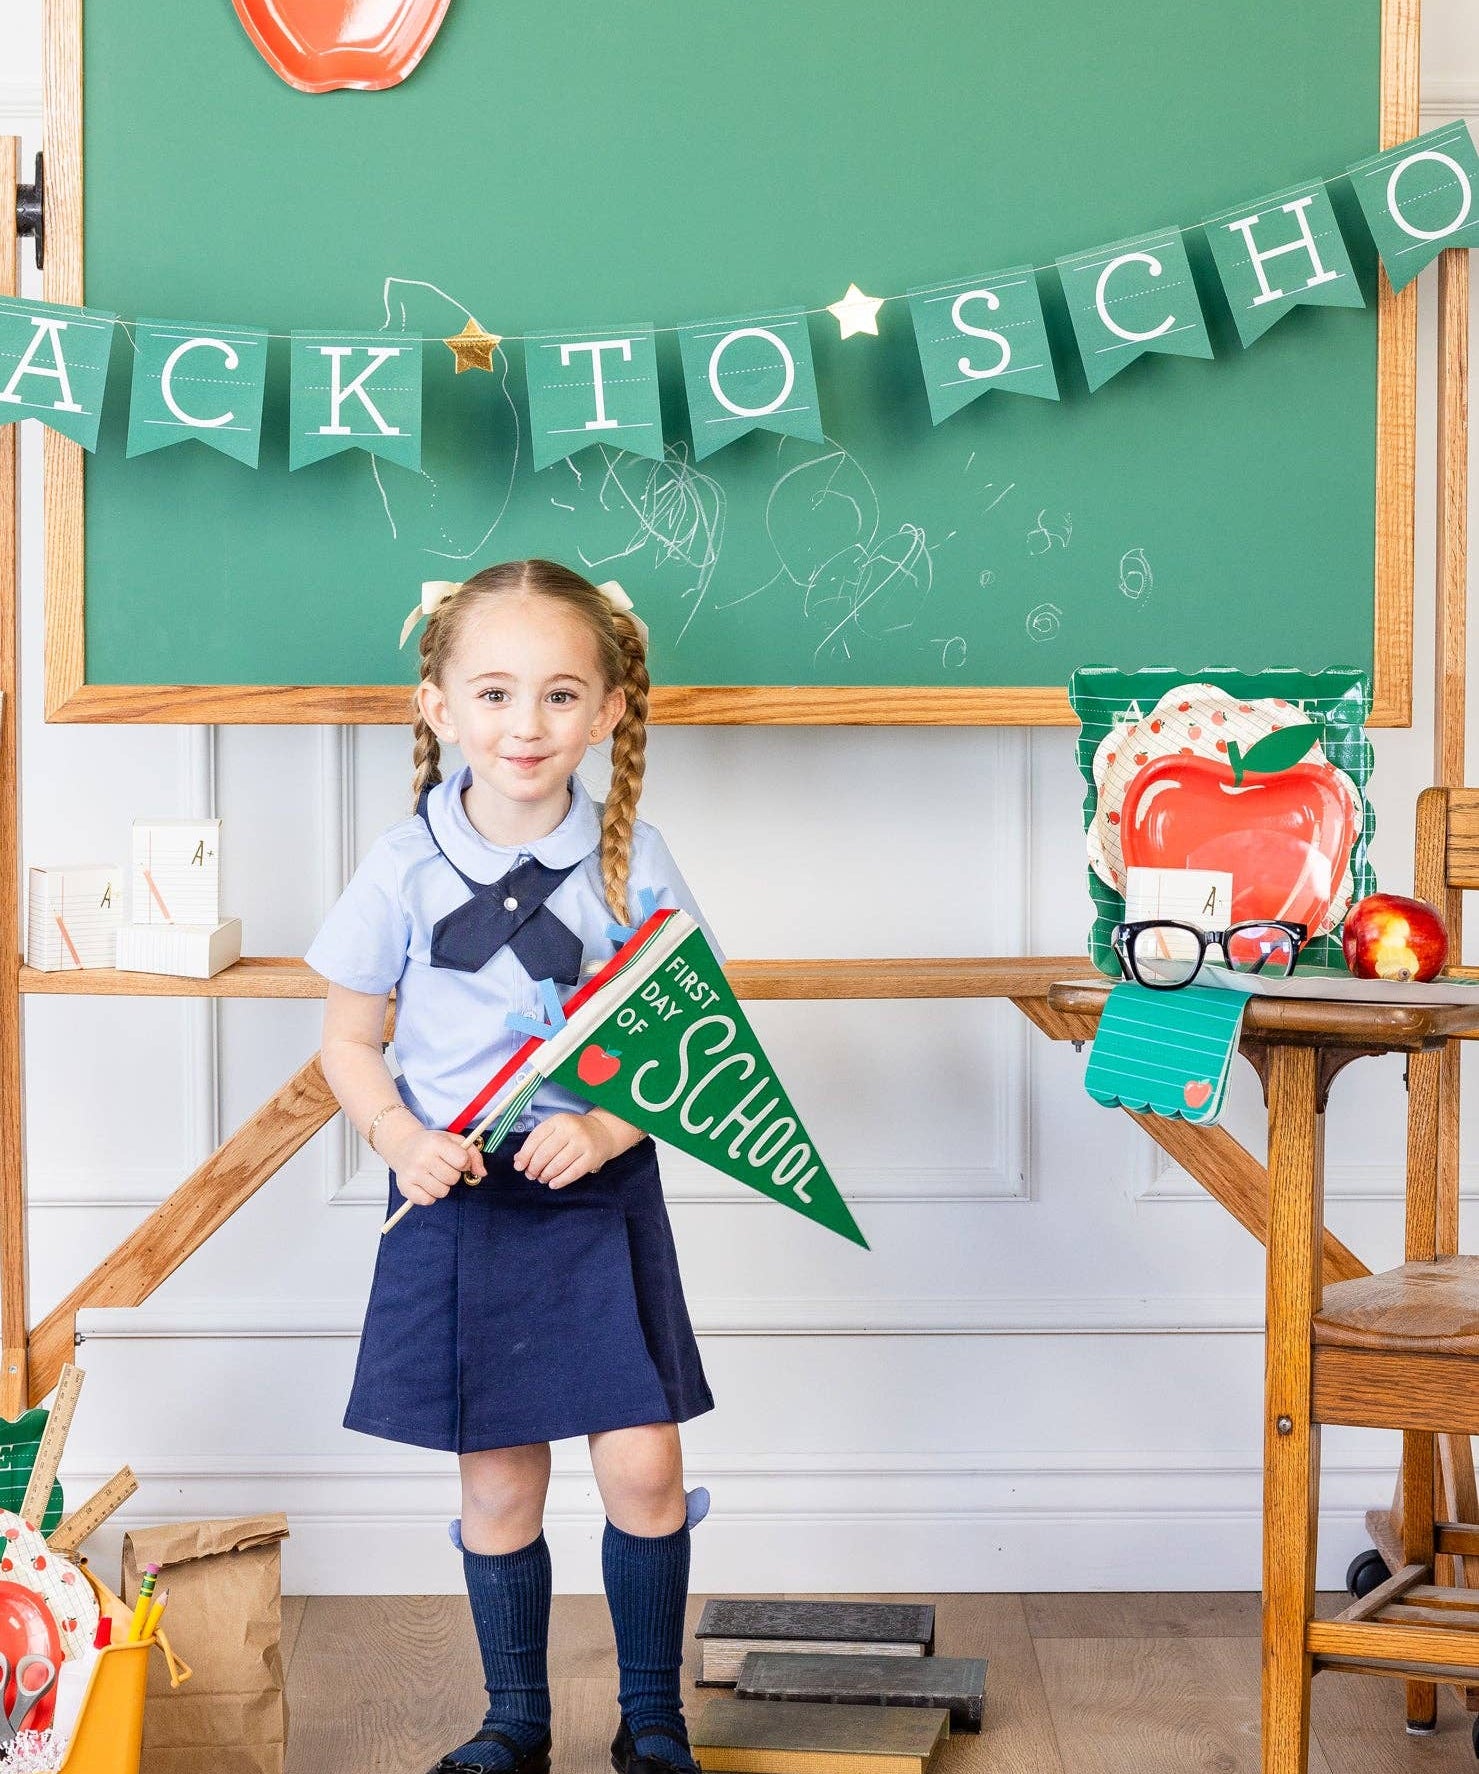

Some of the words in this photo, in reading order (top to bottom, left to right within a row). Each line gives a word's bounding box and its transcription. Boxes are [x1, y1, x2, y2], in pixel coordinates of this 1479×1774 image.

[560, 328, 794, 430] TO
[192, 840, 214, 867] A+
[640, 981, 683, 1022] DAY
[665, 956, 720, 1010] FIRST
[616, 1008, 648, 1036] OF
[630, 1014, 819, 1204] SCHOOL
